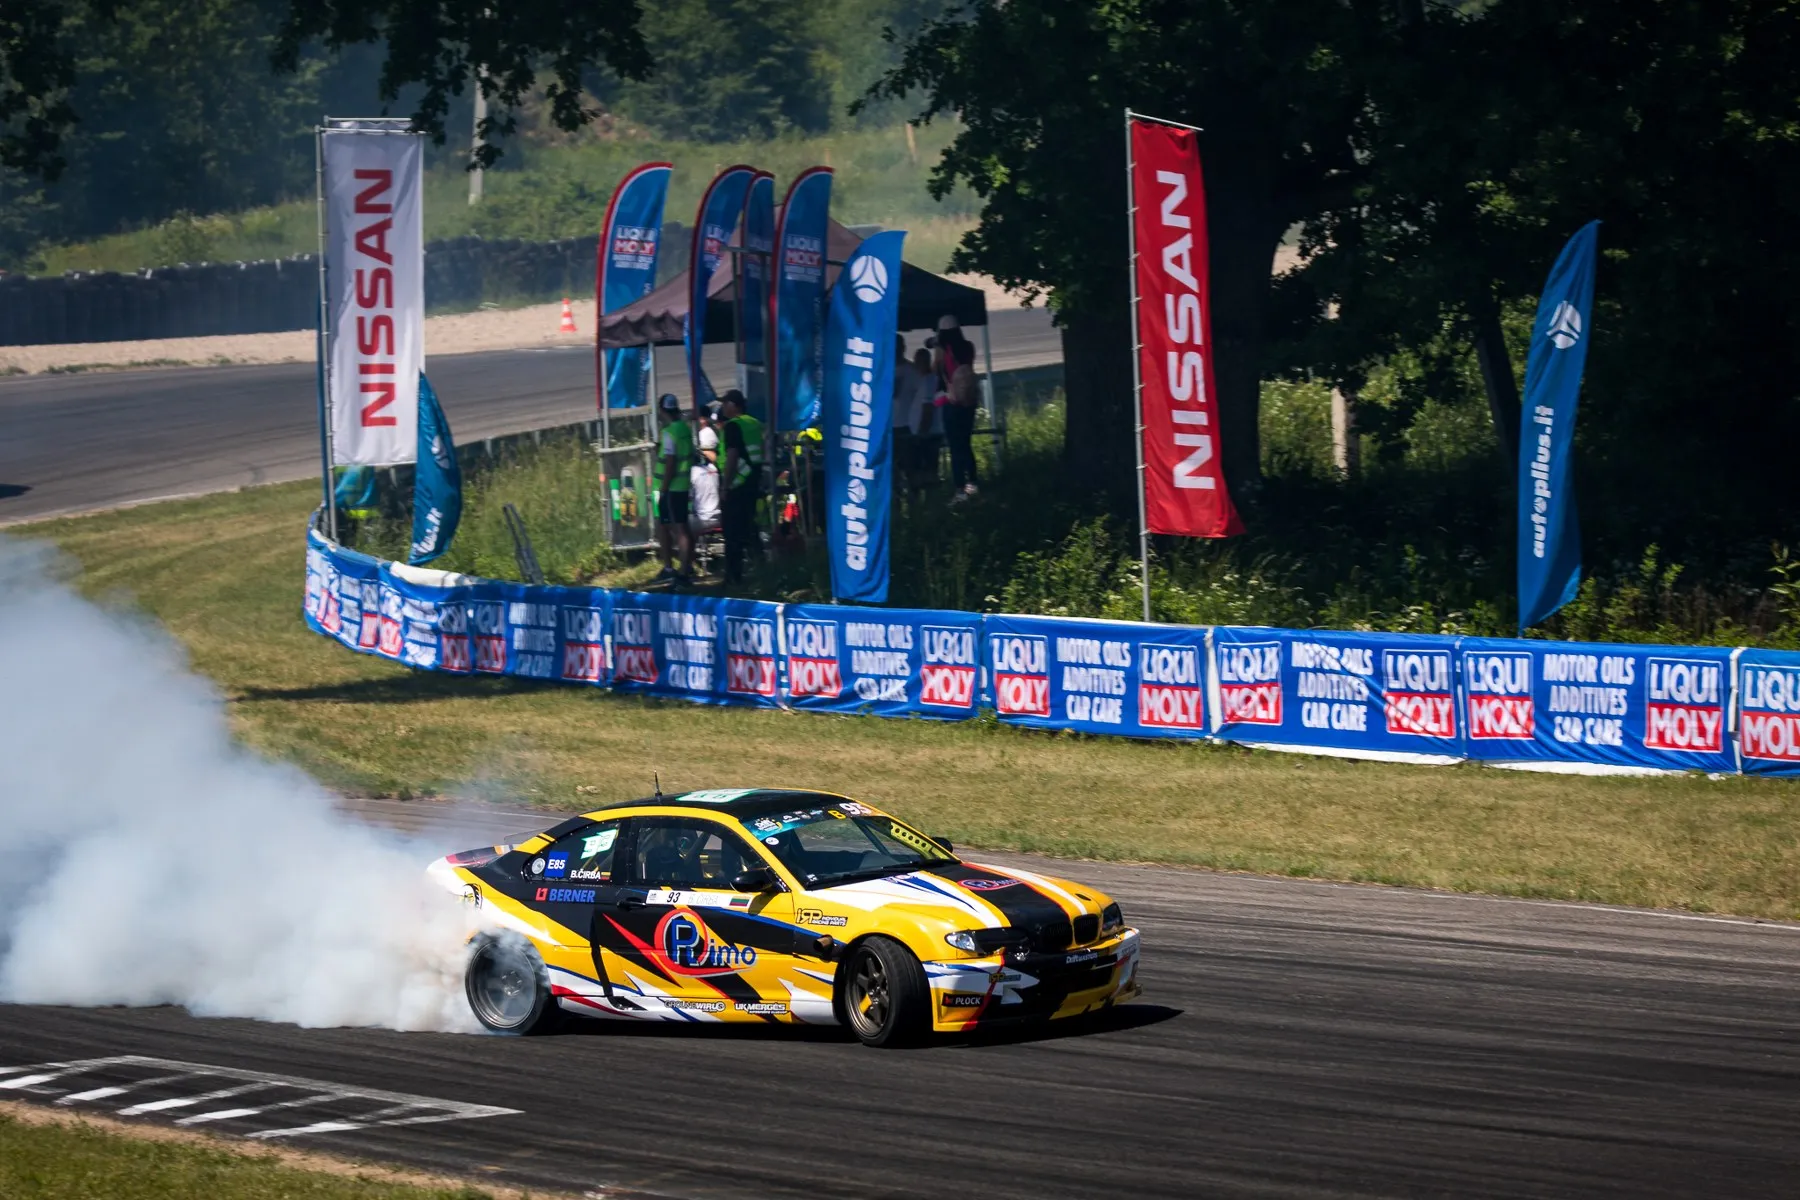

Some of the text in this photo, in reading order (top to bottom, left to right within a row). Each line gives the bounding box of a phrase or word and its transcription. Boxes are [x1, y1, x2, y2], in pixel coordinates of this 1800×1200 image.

[354, 168, 397, 428] NISSAN
[1156, 169, 1216, 491] NISSAN
[840, 336, 875, 572] autoplius.lt
[1533, 404, 1555, 559] autoplius.lt
[726, 620, 774, 655] LIQUI
[787, 622, 837, 659] LIQUI
[922, 630, 975, 665] LIQUI
[1056, 637, 1132, 668] MOTOR OILS
[991, 637, 1047, 675] LIQUI
[1141, 648, 1197, 685] LIQUI
[1221, 647, 1280, 684] LIQUI
[1385, 654, 1450, 692] LIQUI
[1543, 653, 1636, 686] MOTOR OILS
[727, 658, 776, 694] MOLY
[790, 660, 840, 694] MOLY
[922, 667, 976, 702] MOLY
[1062, 666, 1127, 695] ADDITIVES
[1467, 655, 1530, 695] LIQUI
[1649, 663, 1719, 704] LIQUI
[997, 677, 1049, 712] MOLY
[1065, 695, 1123, 724] CAR CARE
[1140, 687, 1201, 724] MOLY
[1221, 687, 1281, 723] MOLY
[1548, 685, 1628, 716] ADDITIVES
[1301, 701, 1368, 732] CAR CARE
[1386, 695, 1454, 738] MOLY
[1468, 699, 1533, 735] MOLY
[1553, 716, 1624, 747] CAR CARE
[1649, 707, 1721, 748] MOLY
[1743, 715, 1800, 756] MOL
[547, 858, 566, 870] E85
[548, 888, 597, 903] BERNER
[666, 891, 682, 904] 93
